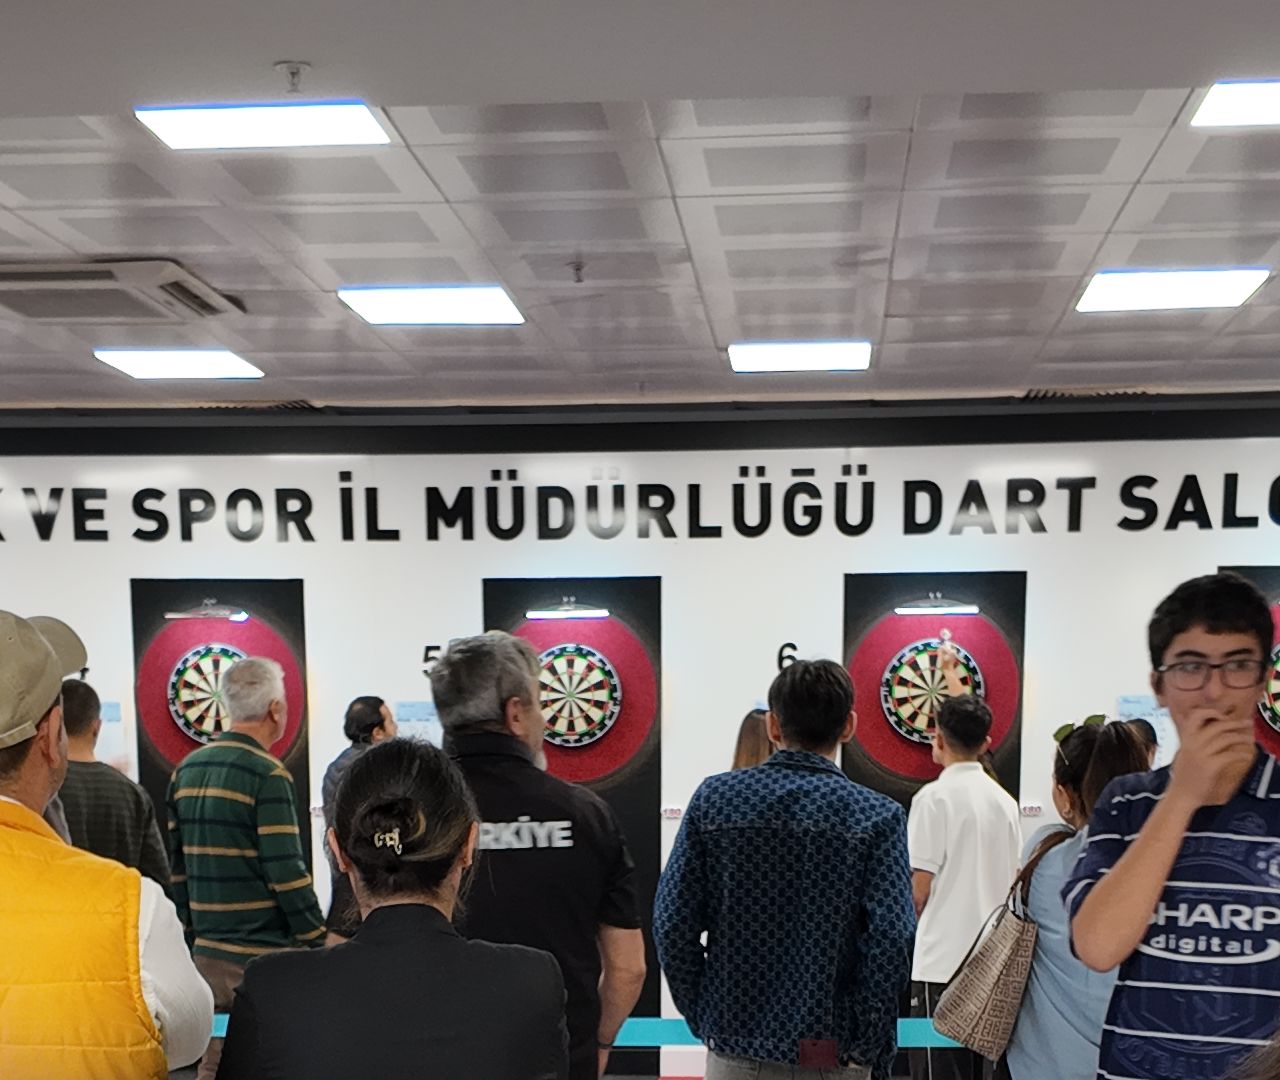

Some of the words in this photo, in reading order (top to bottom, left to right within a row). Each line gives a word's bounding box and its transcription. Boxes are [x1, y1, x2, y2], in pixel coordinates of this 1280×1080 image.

[22, 487, 109, 543] VE
[131, 487, 316, 543] SPOR
[338, 470, 401, 542] İL
[424, 463, 876, 542] MÜDÜRLÜĞÜ
[902, 475, 1098, 536] DART
[777, 641, 798, 671] 6
[478, 815, 575, 850] RKİYE
[1149, 933, 1255, 955] digital
